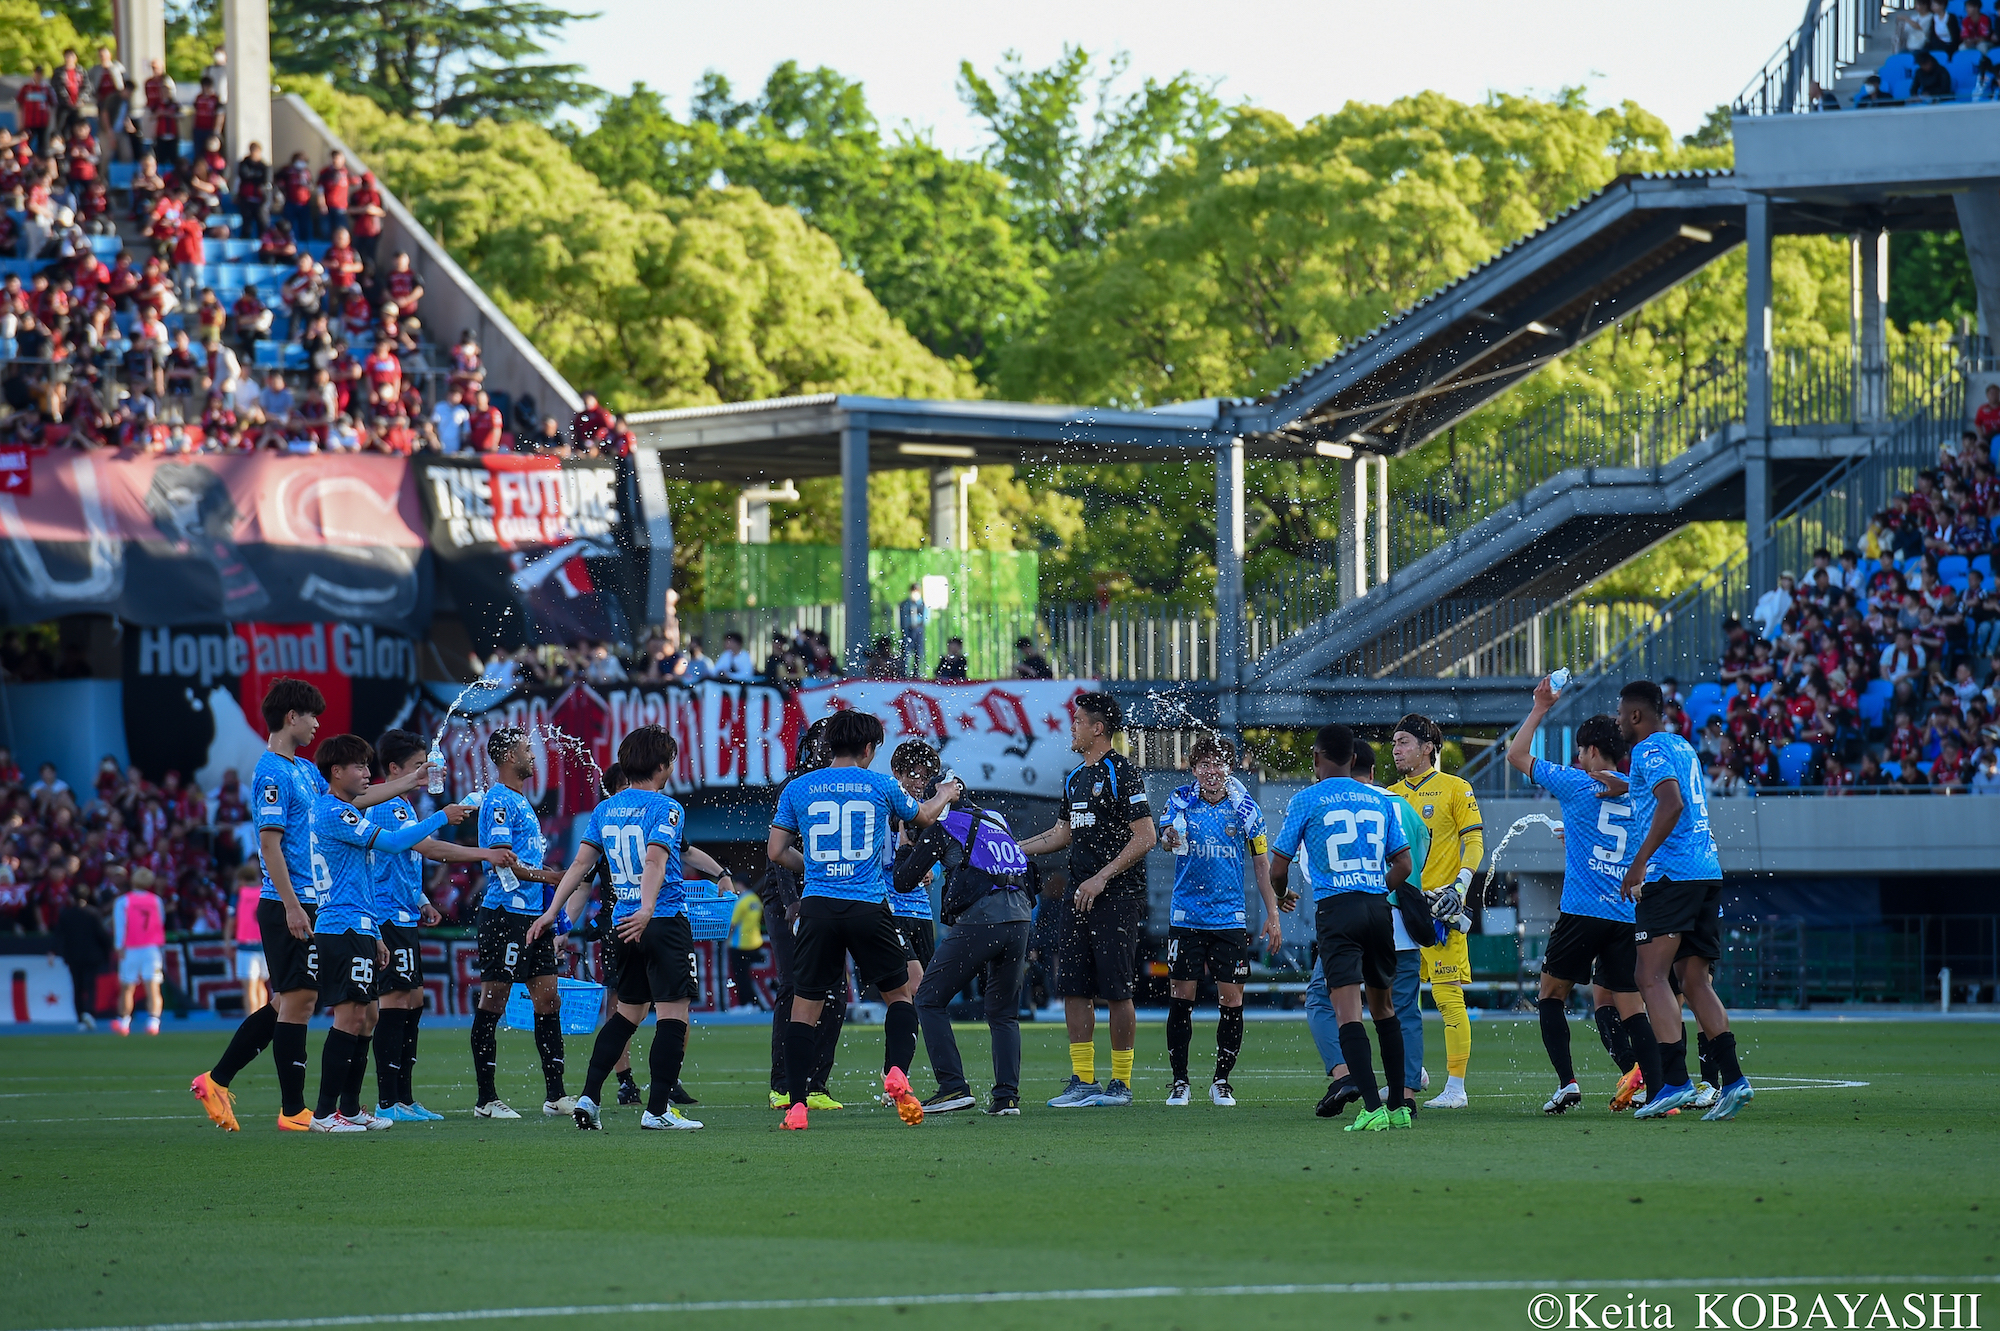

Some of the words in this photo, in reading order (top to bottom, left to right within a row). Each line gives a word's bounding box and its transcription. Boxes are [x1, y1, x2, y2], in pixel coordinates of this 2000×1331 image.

[426, 465, 496, 520] THE
[497, 467, 621, 522] FUTURE
[139, 626, 251, 687] Hope
[253, 621, 328, 673] and
[601, 824, 647, 885] 30
[807, 800, 876, 862] 20
[1322, 808, 1386, 872] 23
[1592, 801, 1632, 863] 5
[826, 863, 855, 877] SHIN
[351, 956, 374, 984] 26
[394, 947, 415, 972] 31
[504, 942, 519, 966] 6
